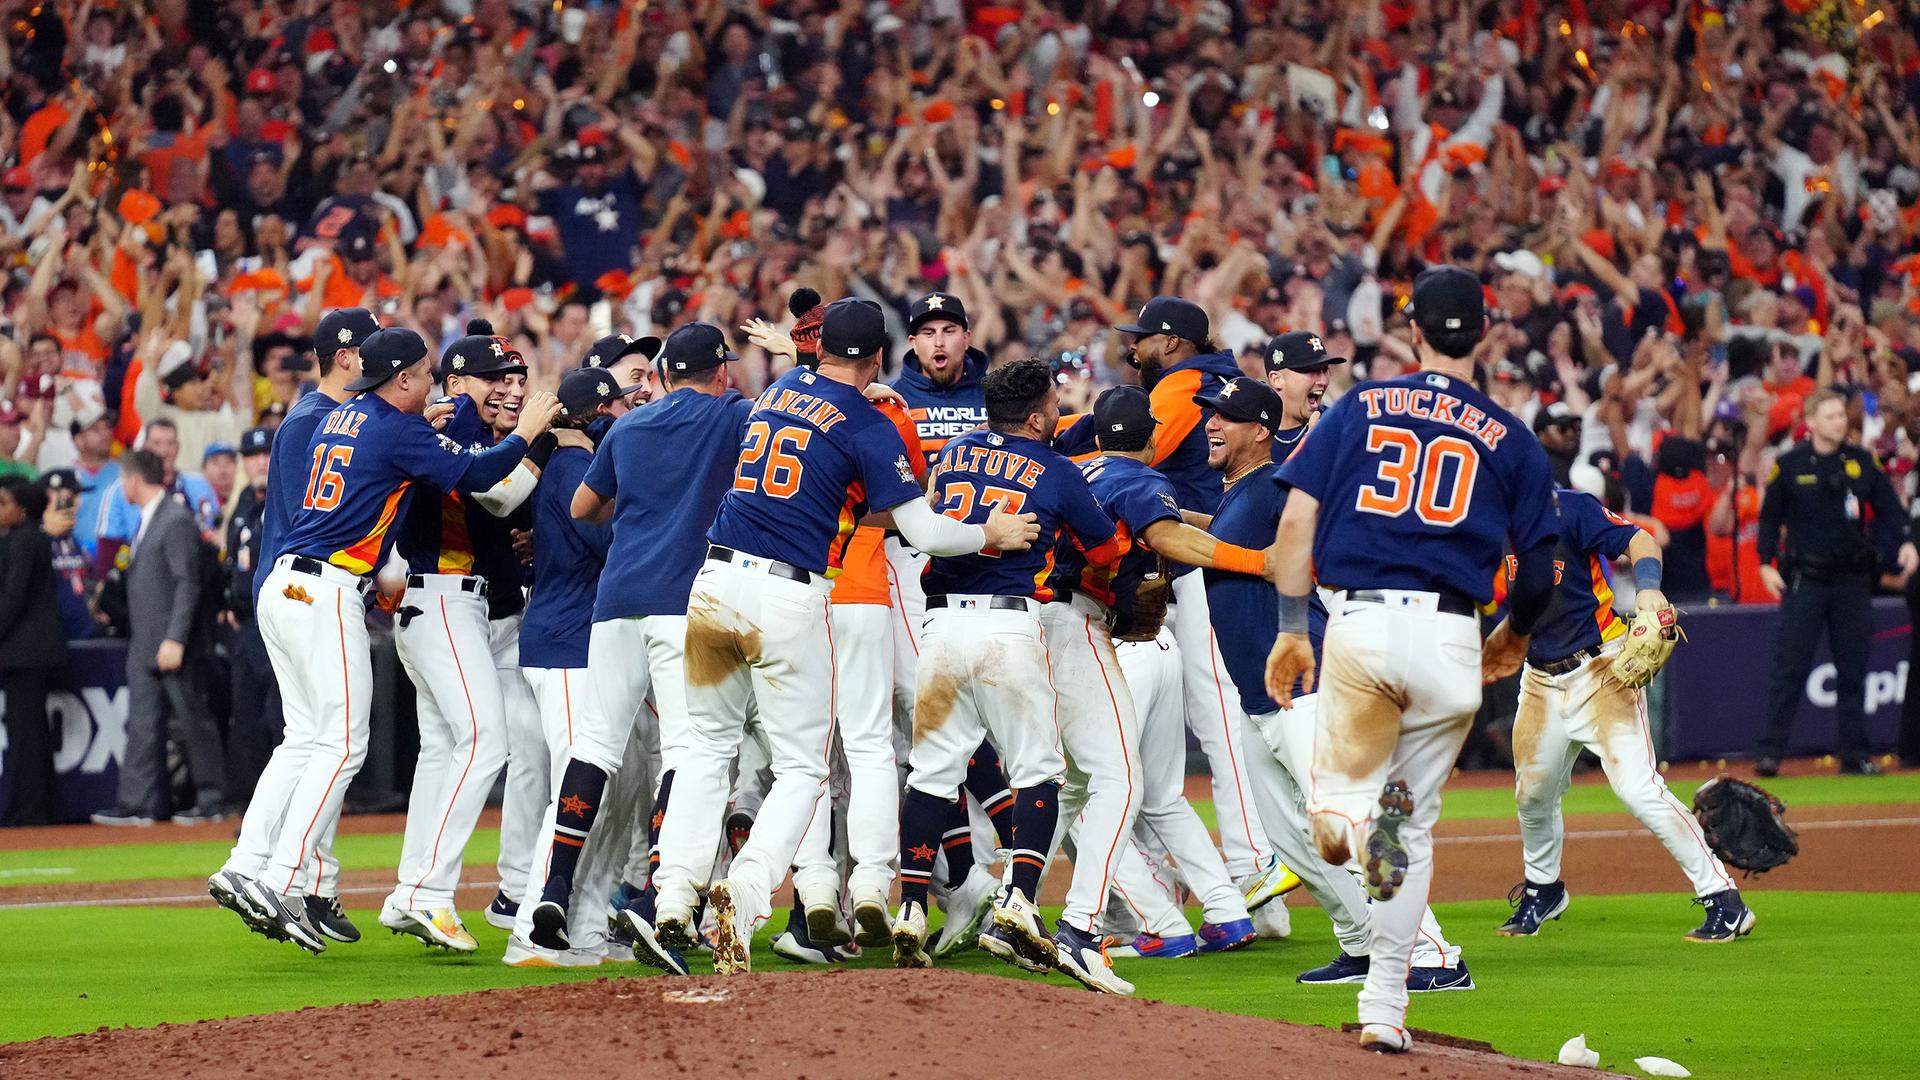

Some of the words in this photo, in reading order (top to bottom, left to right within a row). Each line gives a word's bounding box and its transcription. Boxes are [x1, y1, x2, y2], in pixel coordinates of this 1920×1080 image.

[916, 422, 976, 437] ERIES
[1359, 387, 1508, 452] TUCKER
[303, 443, 354, 512] 16
[733, 421, 813, 499] 26
[937, 445, 1046, 489] ALTUVE
[1355, 424, 1480, 527] 30
[0, 685, 131, 776] OX
[1011, 901, 1023, 912] 27
